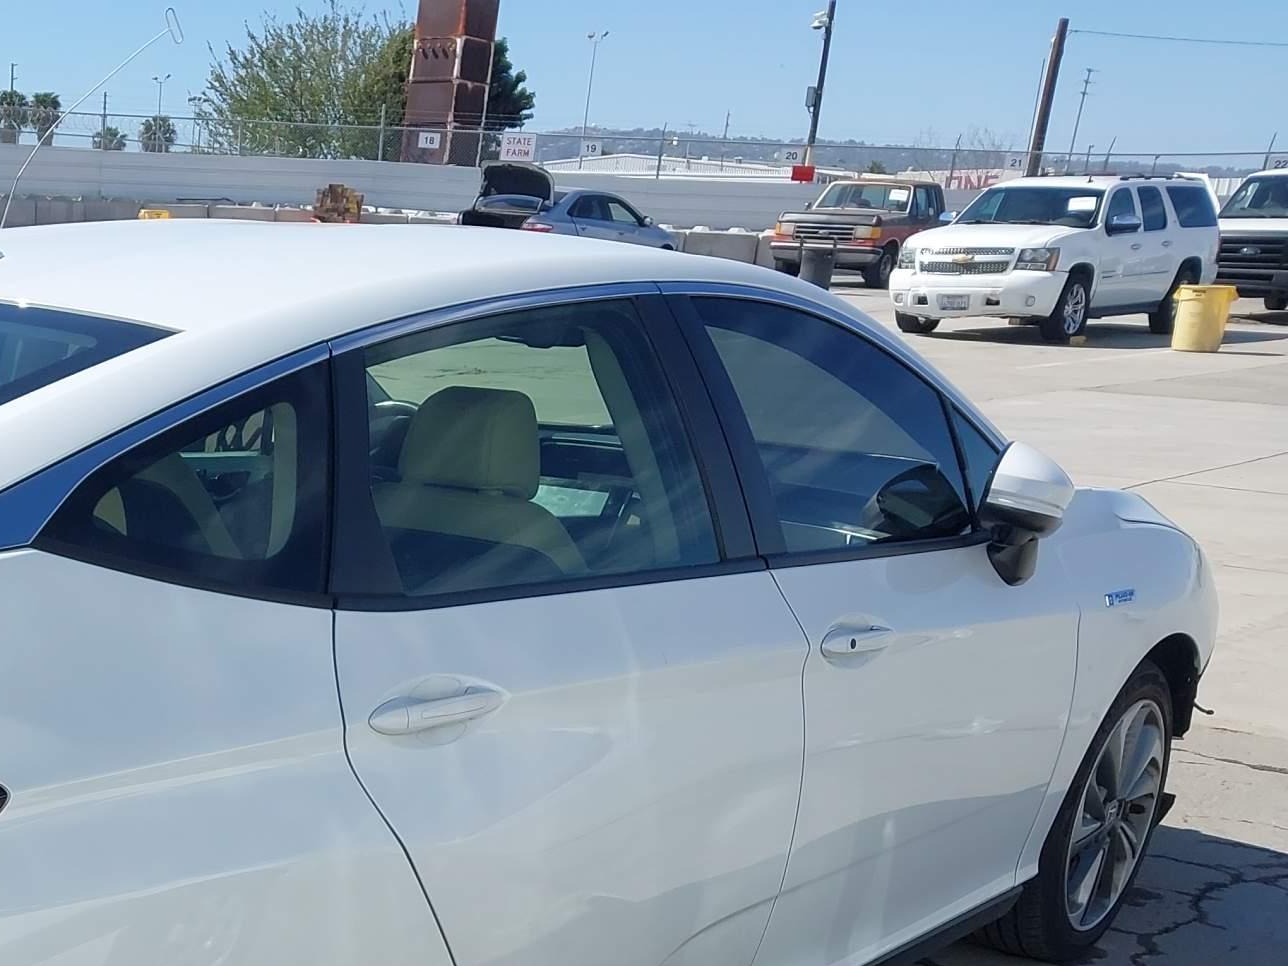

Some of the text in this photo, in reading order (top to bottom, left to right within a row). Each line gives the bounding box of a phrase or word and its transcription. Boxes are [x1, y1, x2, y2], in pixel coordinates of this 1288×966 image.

[424, 136, 434, 145] 18
[506, 137, 532, 146] STATE
[506, 148, 530, 157] FARM
[585, 144, 597, 153] 19
[785, 151, 798, 160] 20
[1010, 158, 1022, 167] 21
[1274, 160, 1288, 169] 22
